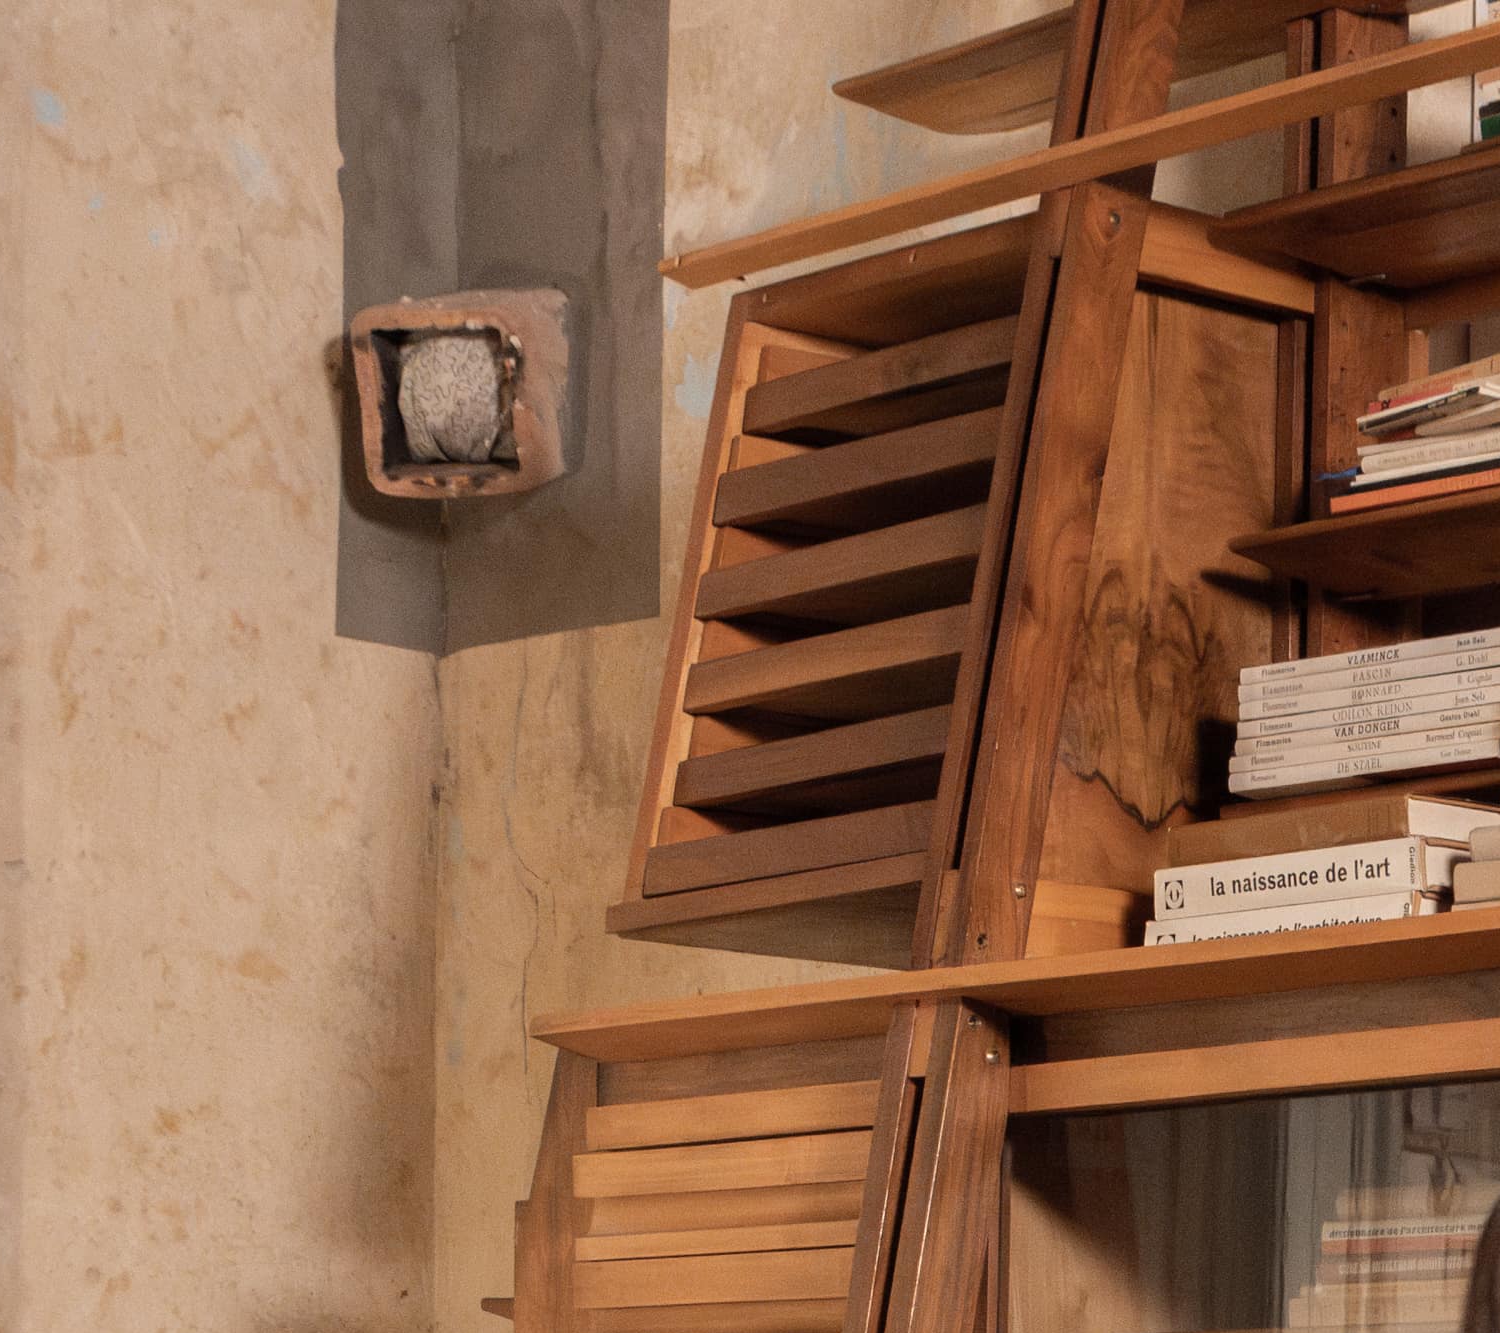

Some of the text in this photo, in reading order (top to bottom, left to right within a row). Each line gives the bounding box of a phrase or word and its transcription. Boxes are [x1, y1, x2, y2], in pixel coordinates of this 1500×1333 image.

[1347, 649, 1400, 665] VLAMINCK
[1334, 719, 1401, 738] VAN DONGEN
[1210, 857, 1392, 897] la naissance de l'art
